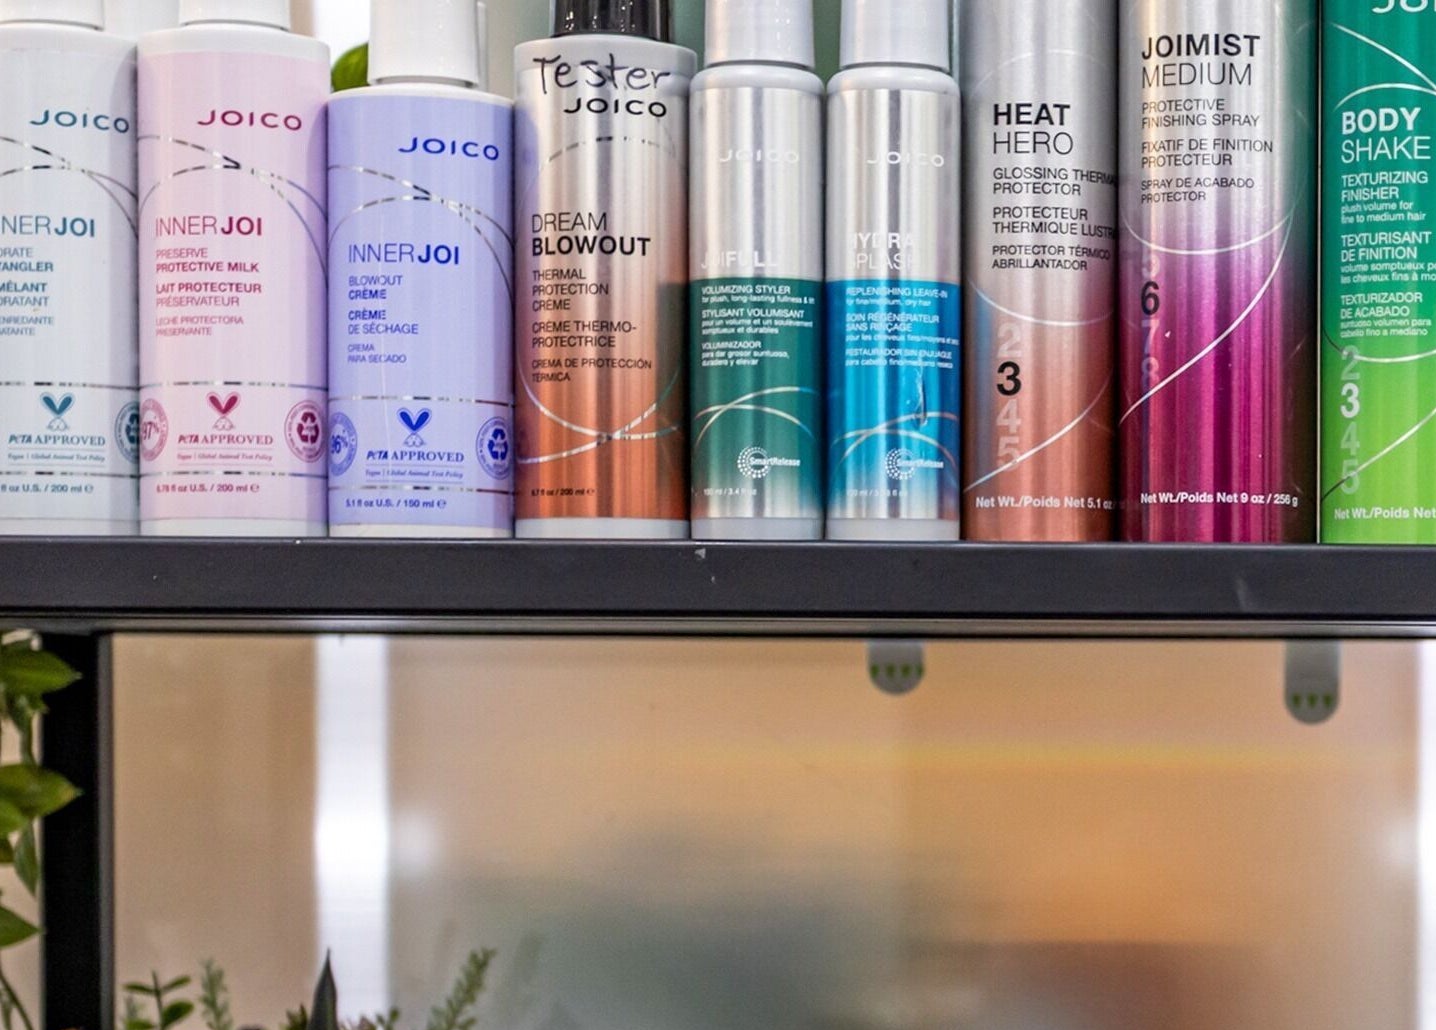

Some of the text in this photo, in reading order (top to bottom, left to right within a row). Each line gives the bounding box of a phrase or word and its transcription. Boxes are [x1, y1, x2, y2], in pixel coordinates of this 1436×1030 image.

[1142, 34, 1260, 60] JOIMIST
[533, 53, 670, 94] Tester
[1142, 62, 1251, 88] MEDIUM
[564, 98, 666, 117] JOICO
[993, 103, 1070, 125] HEAT
[1142, 99, 1225, 114] PROTECTIVE
[30, 110, 129, 134] JOICO
[197, 110, 302, 131] JOICO
[1142, 114, 1259, 129] FINISHING SPRAY
[1342, 107, 1421, 135] BODY
[398, 137, 499, 161] JOICO
[994, 131, 1073, 155] HERO
[1142, 139, 1273, 153] FIXATIF DE FINITION
[1341, 136, 1431, 163] SHAKE
[1142, 154, 1232, 168] PROTECTEUR
[993, 167, 1068, 180] GLOSSING
[1341, 172, 1428, 186] TEXTURIZING
[993, 183, 1080, 195] PROTECTOR
[1341, 187, 1399, 202] FINISHER
[993, 207, 1088, 220] PROTECTEUR
[156, 216, 262, 236] INNERJOI
[532, 212, 607, 233] DREAM
[993, 222, 1077, 235] THERMIQUE
[532, 236, 651, 256] BLOWOUT
[1341, 232, 1432, 246] TEXTURISANT
[349, 243, 459, 265] INNERJOI
[1341, 247, 1417, 262] DE FINITION
[156, 262, 259, 273] PROTECTIVE MILK
[533, 269, 586, 281] THERMAL
[178, 283, 262, 293] PROTECTEUR
[349, 275, 403, 286] BLOWOUT
[532, 284, 609, 296] PROTECTION
[1141, 281, 1159, 315] 6
[1341, 293, 1422, 305] TEXTURIZADOR
[532, 336, 615, 348] PROTECTRICE
[997, 362, 1021, 396] 3
[1341, 383, 1360, 418] 3
[202, 435, 273, 445] APPROVED
[1217, 493, 1237, 503] Net
